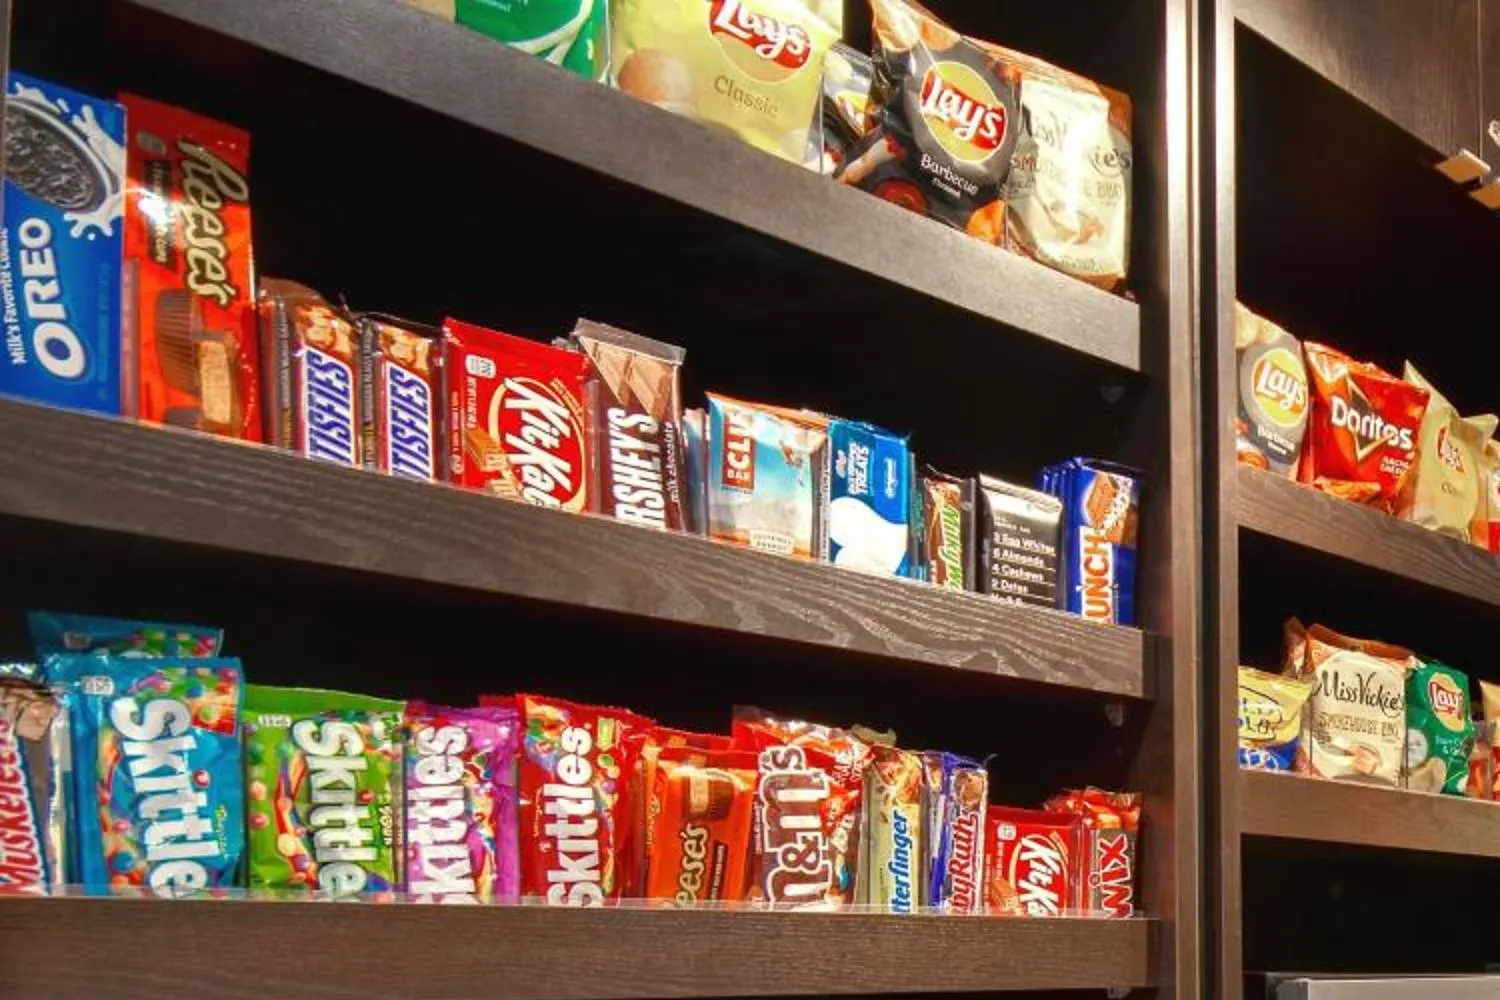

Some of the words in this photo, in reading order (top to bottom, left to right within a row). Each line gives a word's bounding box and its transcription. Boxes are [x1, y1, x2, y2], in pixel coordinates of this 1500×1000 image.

[714, 0, 811, 59] Lay's
[713, 74, 779, 119] Classic
[919, 75, 1004, 141] Lay's
[920, 153, 979, 197] Barbecue
[177, 140, 249, 306] Reese's
[2, 271, 18, 323] Favorite
[18, 217, 86, 379] OREO
[7, 325, 27, 364] Milk's
[306, 350, 351, 464] TISFIES
[389, 366, 430, 478] TISFIES
[1330, 395, 1413, 450] Doritos
[608, 407, 666, 529] RSHEY'S
[1083, 533, 1110, 619] UNCH
[1312, 669, 1356, 702] Miss
[1355, 671, 1405, 718] Vickie's
[110, 697, 222, 899] Skittle
[292, 719, 378, 901] Skittle
[406, 725, 480, 904] kittles
[675, 824, 709, 907] eese's
[889, 809, 913, 913] tterfinger
[1090, 833, 1133, 918] WIX
